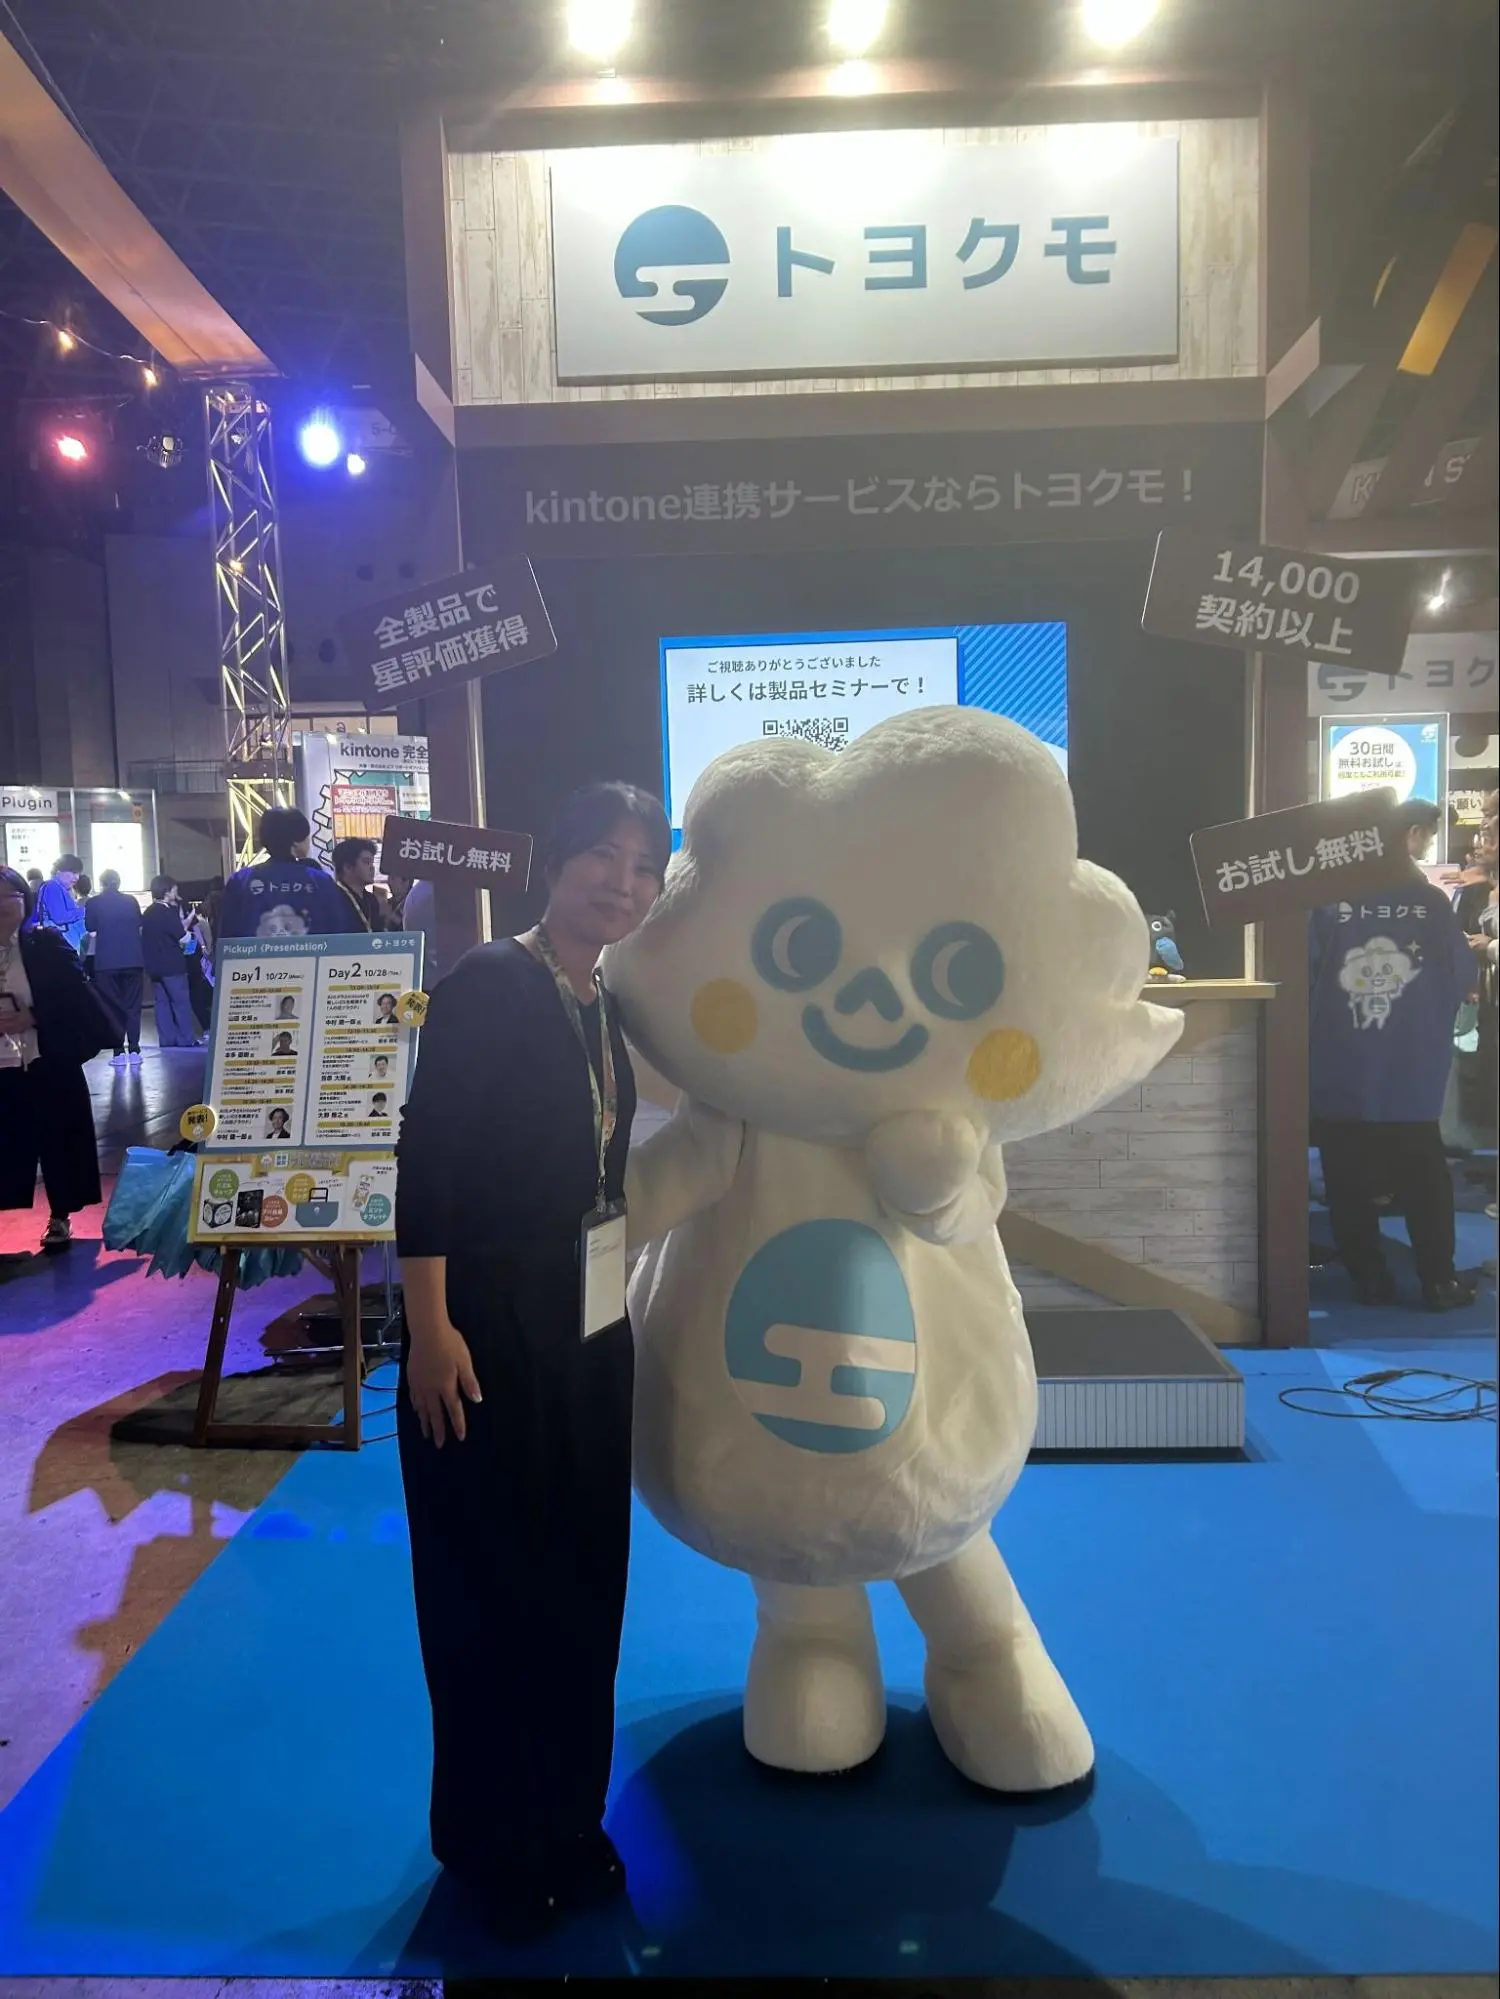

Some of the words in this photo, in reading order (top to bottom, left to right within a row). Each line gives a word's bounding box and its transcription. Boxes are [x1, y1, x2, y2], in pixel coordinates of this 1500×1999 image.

[776, 214, 1118, 298] トヨクモ
[525, 468, 1192, 524] kintone連携サービスならトヨクモ！
[1213, 550, 1360, 604] 14,000
[373, 583, 499, 649] 全製品で
[1195, 593, 1353, 655] 契約以上
[370, 614, 529, 693] 星評価獲得
[707, 655, 881, 674] ご視聴ありがとうございました
[687, 676, 926, 704] 詳しくは製品セミナーで！
[340, 743, 400, 759] kintone
[402, 745, 428, 760] 完全
[1349, 741, 1395, 756] 30日間
[2, 796, 52, 811] Plugin
[399, 837, 512, 873] お試し無料
[1215, 826, 1384, 893] お試し無料
[269, 880, 314, 894] トヨクモ
[1361, 905, 1428, 919] トヨクモ
[384, 938, 416, 947] トヨクモ
[265, 972, 289, 981] 10/27
[364, 969, 388, 977] 10/28
